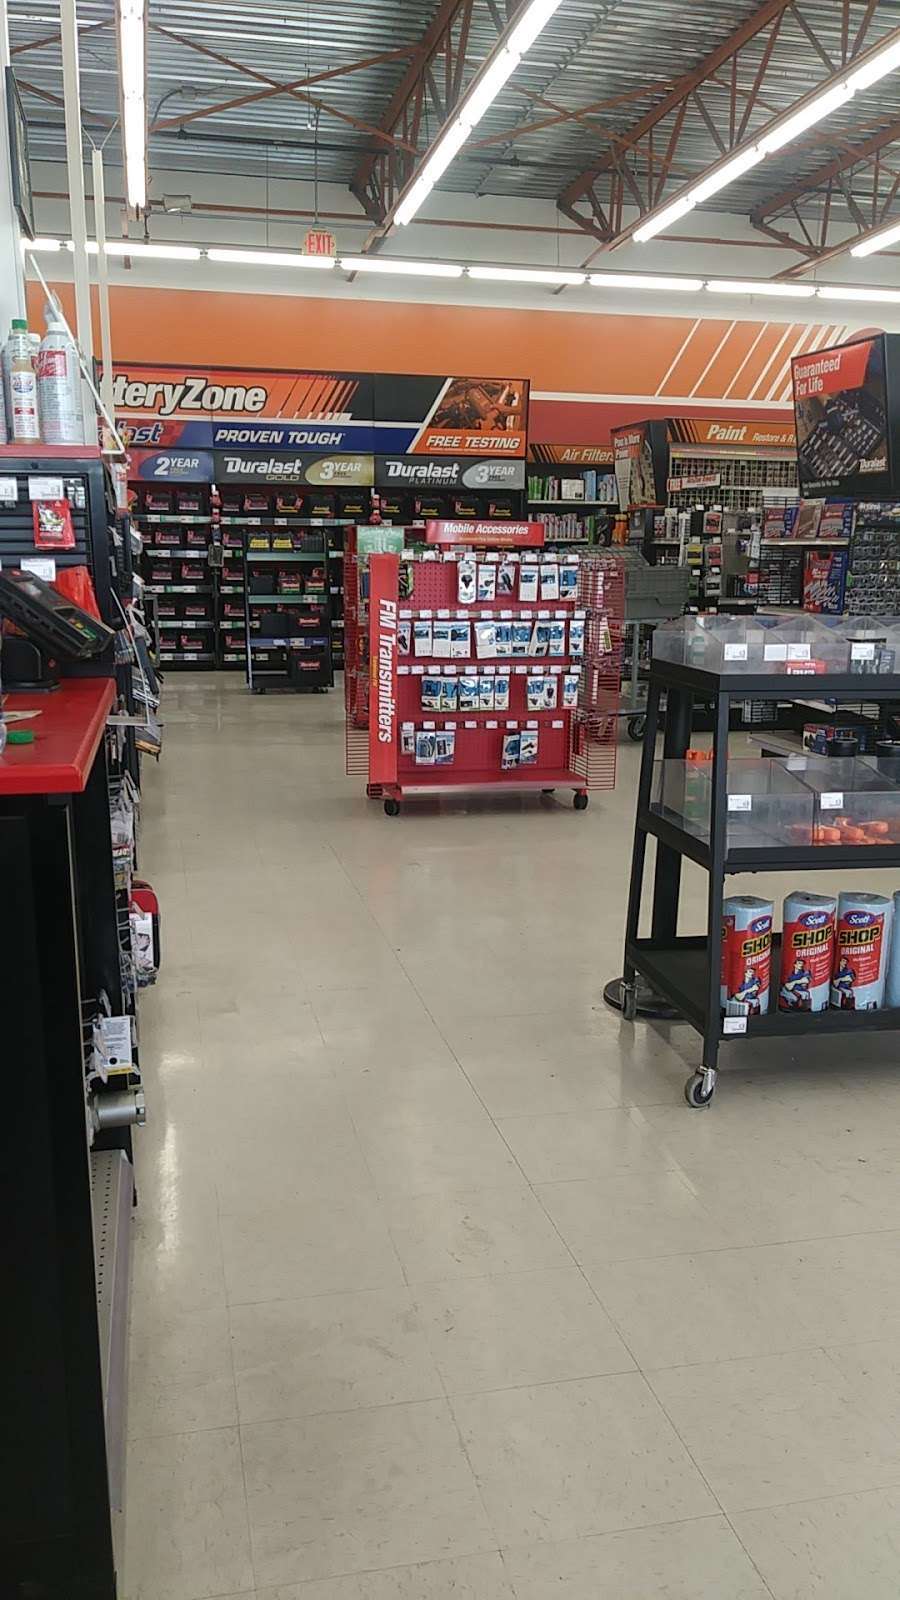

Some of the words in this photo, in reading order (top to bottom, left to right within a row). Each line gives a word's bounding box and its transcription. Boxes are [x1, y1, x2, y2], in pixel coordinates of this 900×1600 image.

[308, 233, 332, 254] EXIT
[793, 354, 842, 379] Guaranteed
[795, 380, 807, 396] For
[808, 377, 824, 394] Life
[215, 429, 284, 444] PROVEN
[287, 431, 343, 445] TOUGH
[426, 435, 462, 448] FREE
[465, 436, 521, 449] TESTING
[706, 423, 748, 441] Paint
[780, 434, 786, 443] &
[560, 448, 579, 461] Air
[581, 448, 614, 462] Filters
[154, 457, 170, 476] 2
[170, 457, 200, 469] YEAR
[223, 456, 302, 474] Duralast
[320, 461, 335, 480] 3
[334, 462, 362, 473] YEAR
[385, 461, 459, 478] Duralast
[475, 465, 489, 483] 3
[489, 465, 516, 477] YEAR
[408, 477, 458, 486] PLATINUM
[443, 522, 474, 534] Mobile
[475, 523, 529, 535] Accessories
[379, 599, 396, 628] FM
[378, 634, 396, 743] Transmitters
[849, 914, 871, 924] Scott
[792, 924, 833, 949] SHOP
[838, 925, 881, 945] SHOP
[796, 943, 829, 958] ORIGINAL
[841, 943, 874, 955] ORIGINAL
